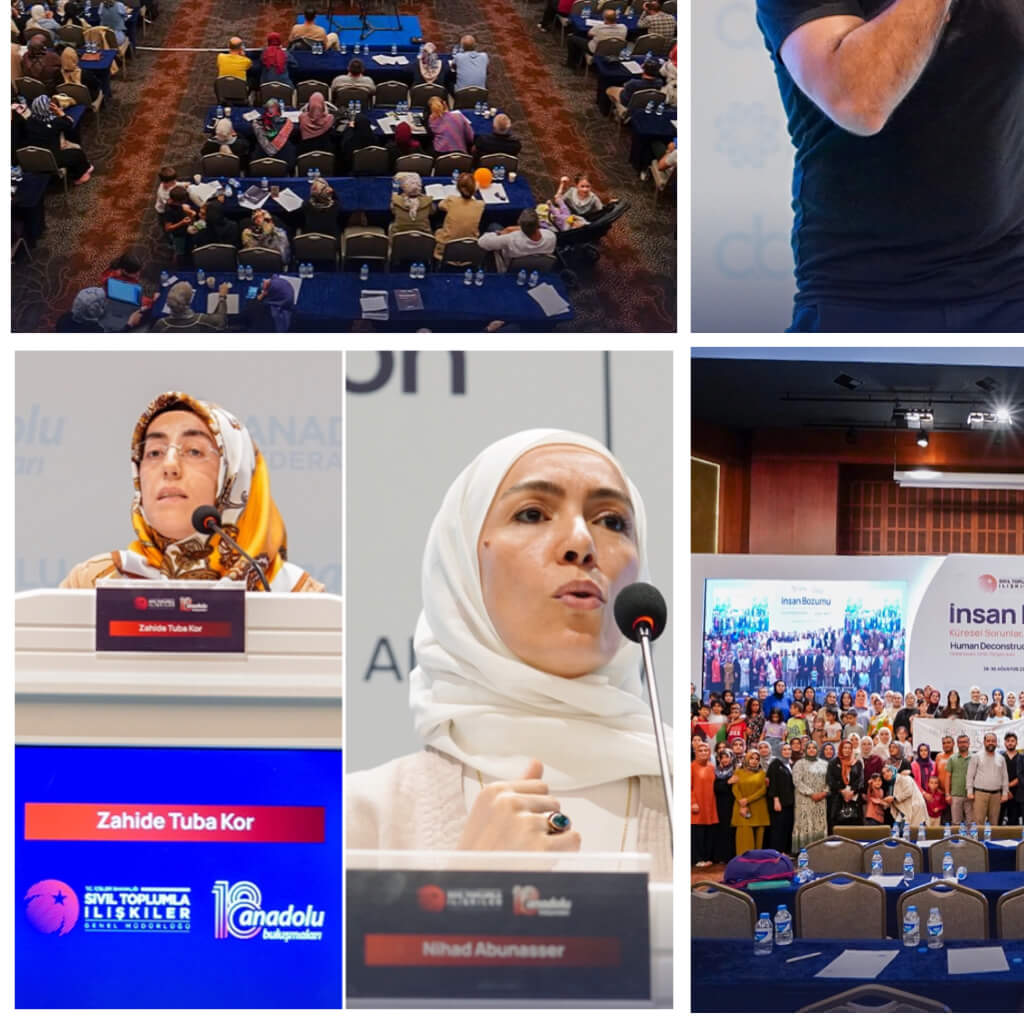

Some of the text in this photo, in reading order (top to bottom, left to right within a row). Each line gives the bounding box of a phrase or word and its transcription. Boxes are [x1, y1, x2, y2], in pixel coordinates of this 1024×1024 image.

[802, 597, 831, 606] Bozumu
[949, 603, 1016, 625] İnsan
[139, 624, 203, 633] Zahide Tuba Kor
[950, 628, 983, 638] Küresel
[950, 642, 979, 651] Human
[97, 811, 255, 831] Zahide Tuba Kor
[119, 893, 191, 906] TOPLUMLA
[239, 905, 326, 927] anadolu
[422, 941, 565, 959] Nihad Abunasser
